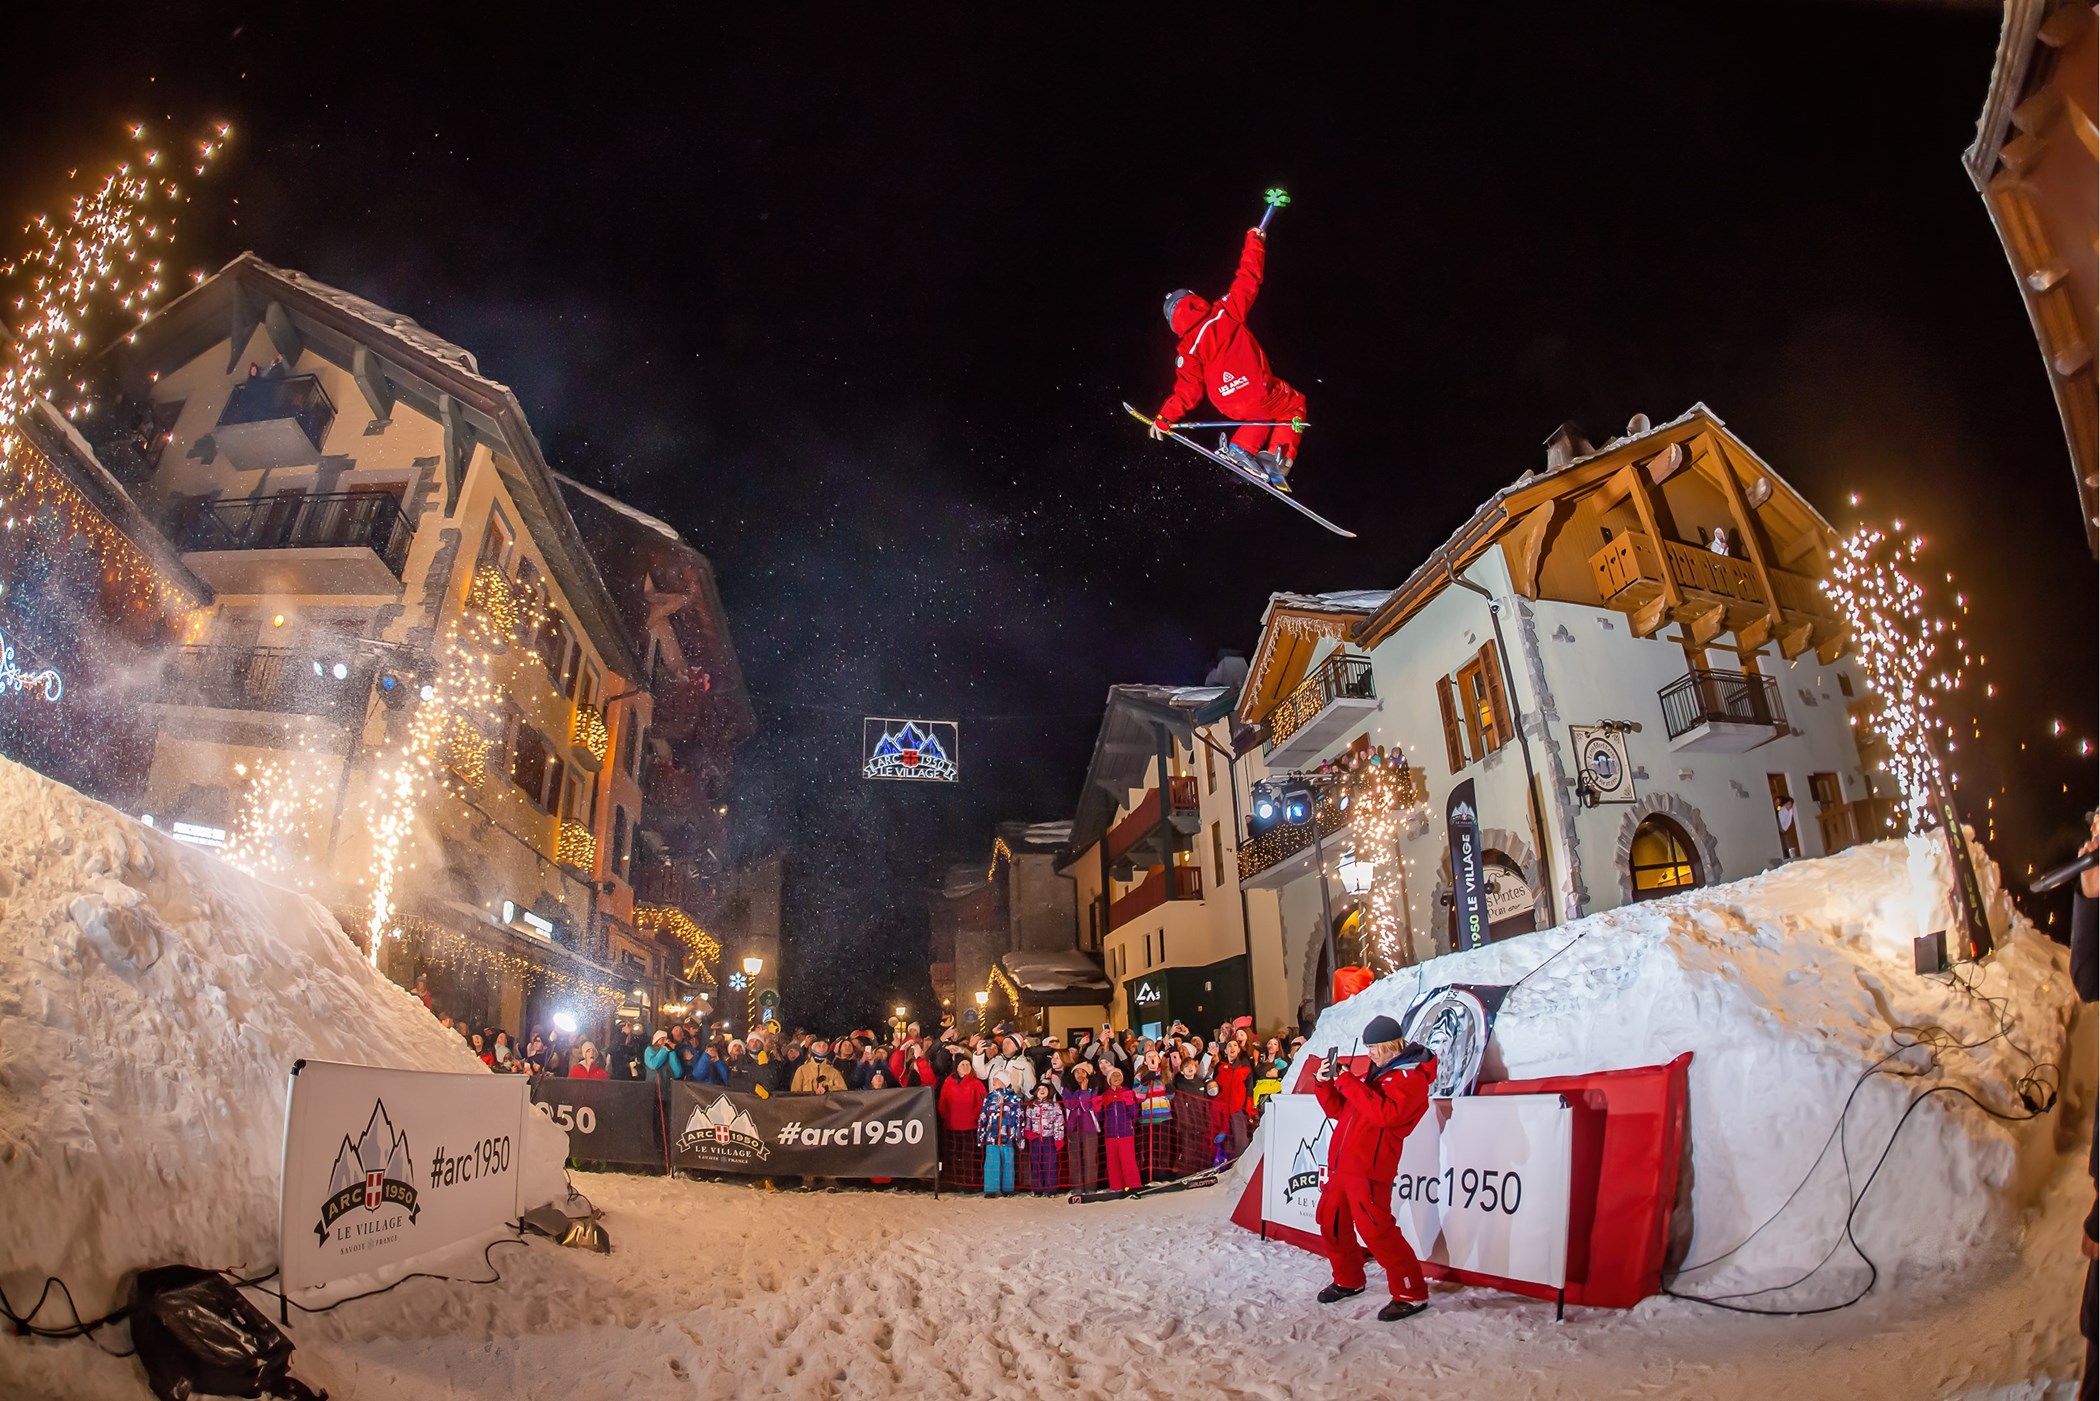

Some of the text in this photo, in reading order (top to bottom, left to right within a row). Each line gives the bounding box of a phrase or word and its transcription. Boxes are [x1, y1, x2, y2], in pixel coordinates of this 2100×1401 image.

[1230, 376, 1248, 389] ARCS
[878, 756, 944, 769] ARC 1950
[880, 767, 940, 778] LE VILLAGE
[1462, 834, 1475, 893] VILLAGE
[1467, 896, 1479, 912] LE
[1492, 886, 1526, 905] Pintes
[1469, 914, 1482, 949] 1950
[687, 1130, 759, 1148] ARC 1950
[777, 1119, 924, 1146] #arc1950
[695, 1145, 752, 1158] LE VILLAGE
[430, 1135, 511, 1189] #arc1950
[1292, 1174, 1316, 1190] ARC
[1390, 1167, 1522, 1215] arc1950
[328, 1184, 413, 1219] ARC 1950
[1297, 1197, 1308, 1208] LE
[337, 1215, 403, 1241] LE VILLAGE
[340, 1234, 399, 1256] SAVOIE FRANCE
